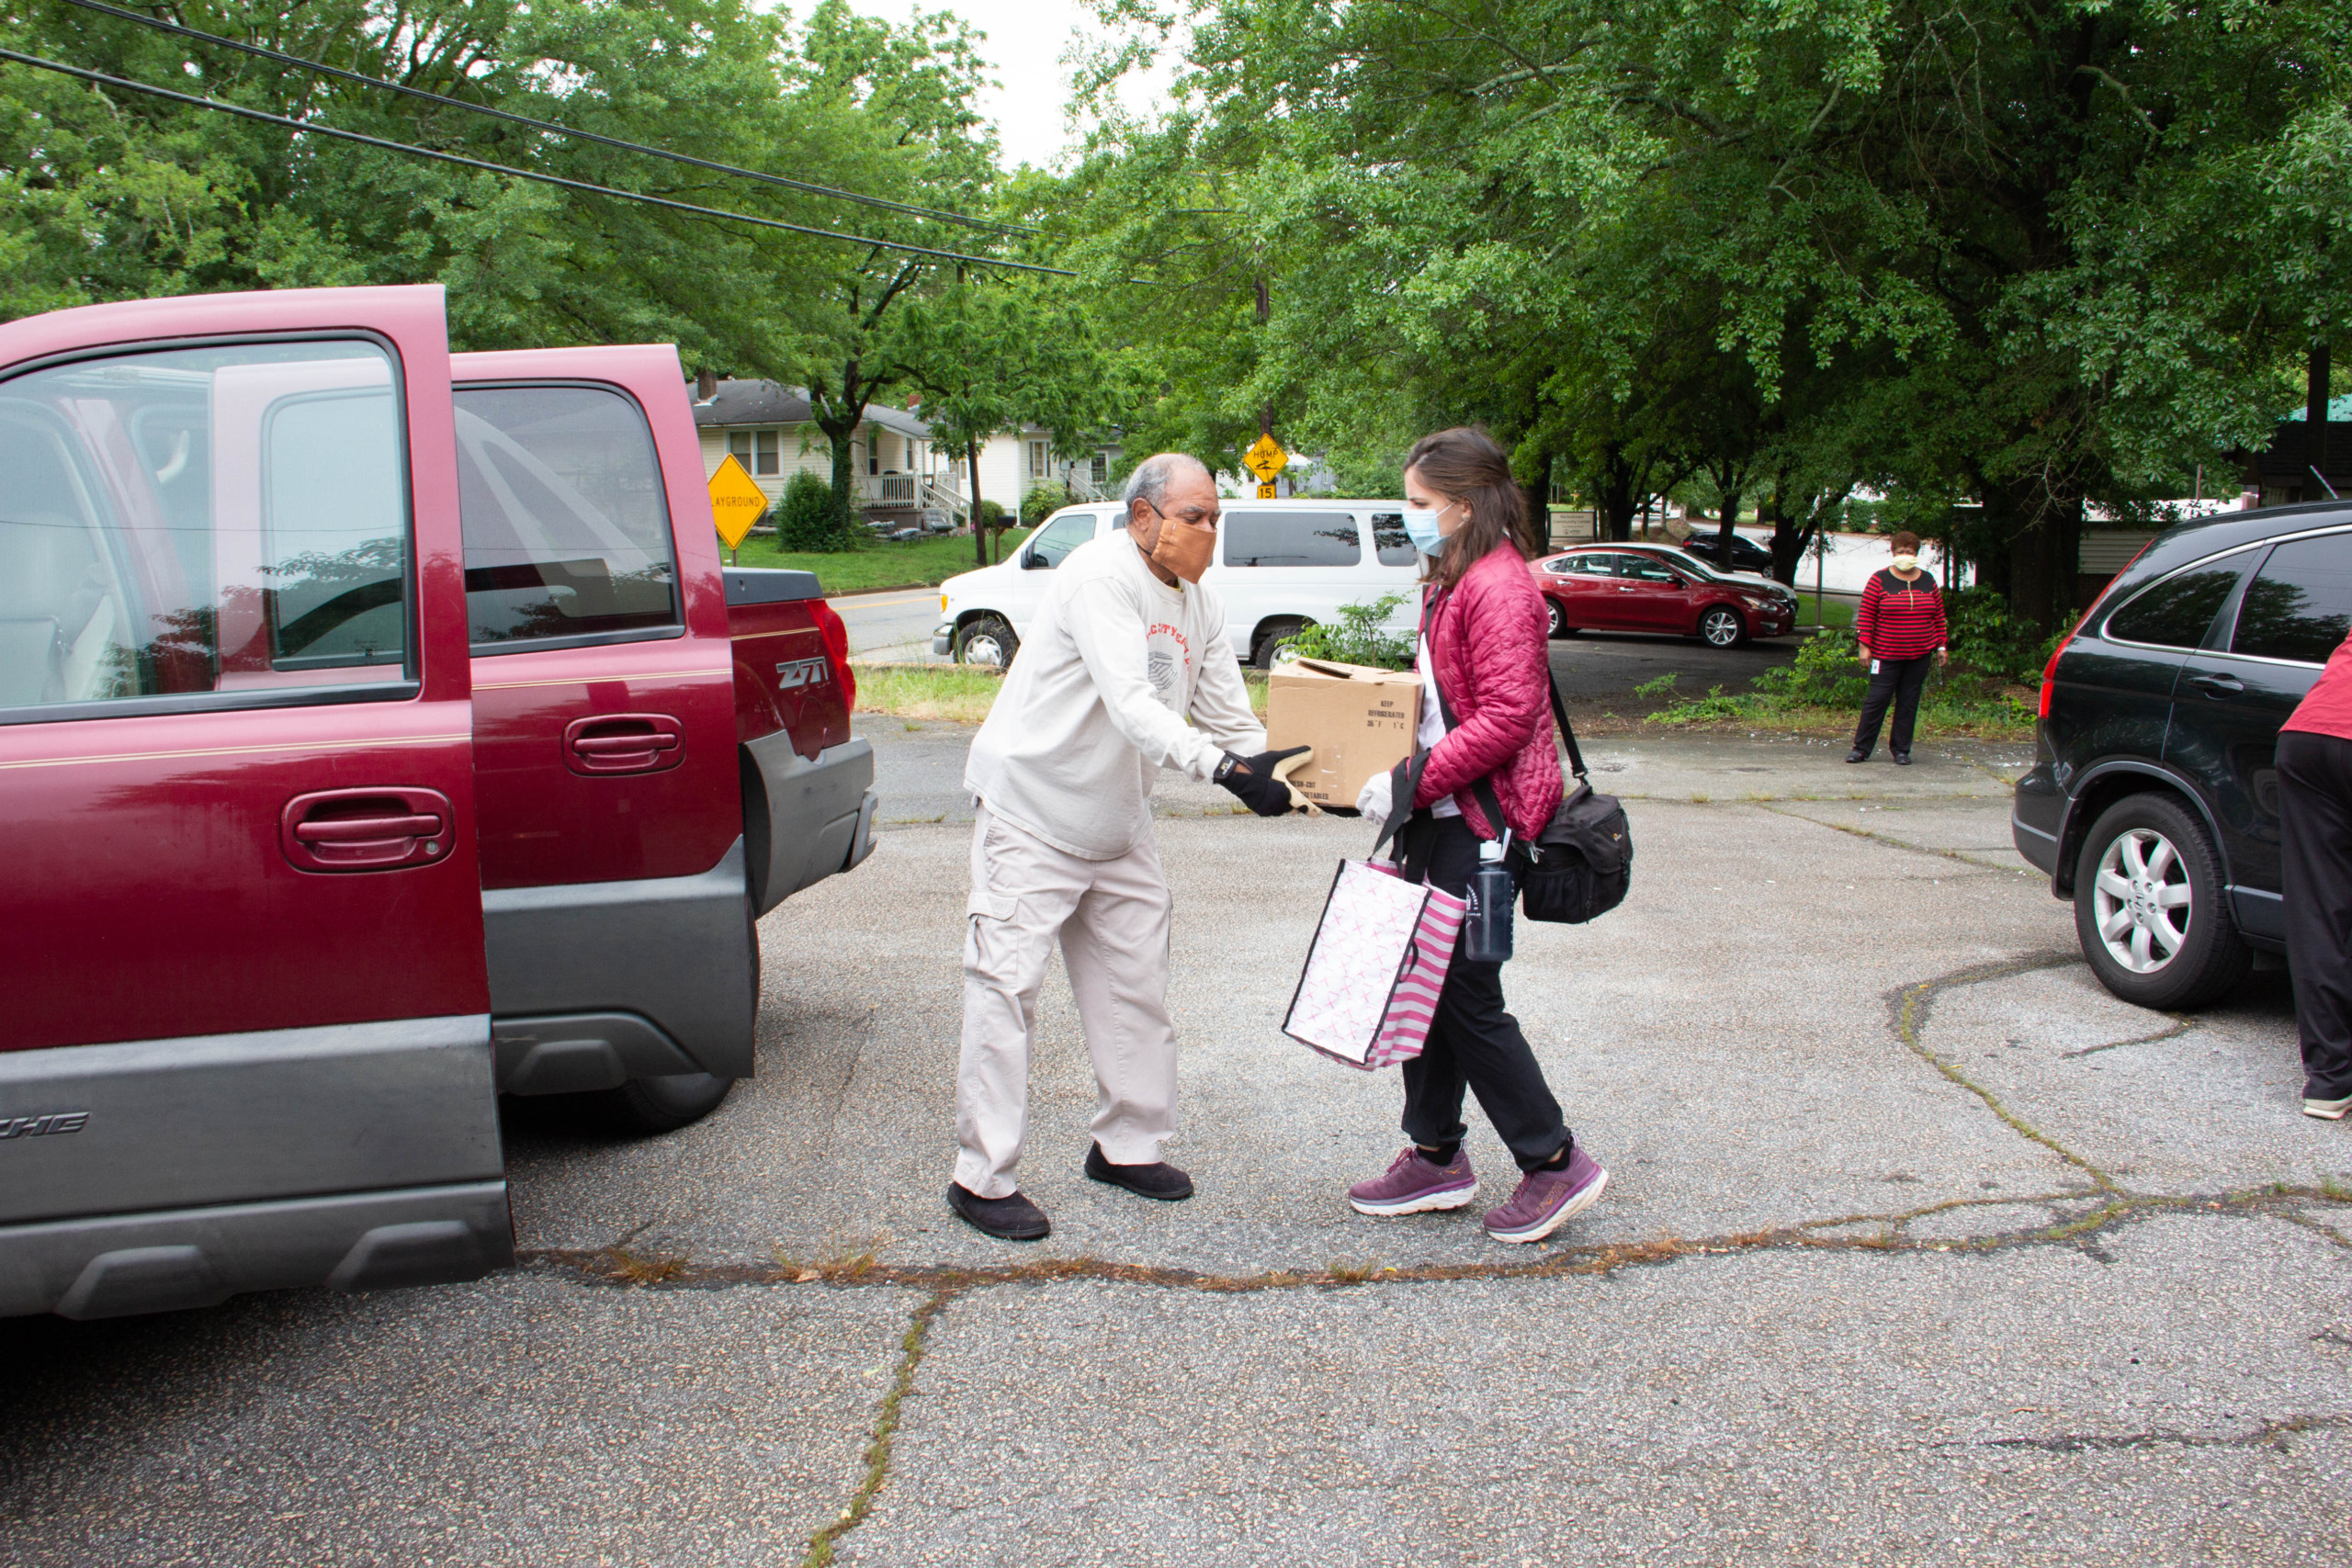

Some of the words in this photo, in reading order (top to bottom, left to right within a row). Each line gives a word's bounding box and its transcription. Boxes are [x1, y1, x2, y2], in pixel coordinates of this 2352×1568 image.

[1253, 450, 1278, 458] HUMP
[1260, 488, 1272, 499] 15
[711, 496, 760, 507] AYGROUND
[775, 656, 829, 690] Z71
